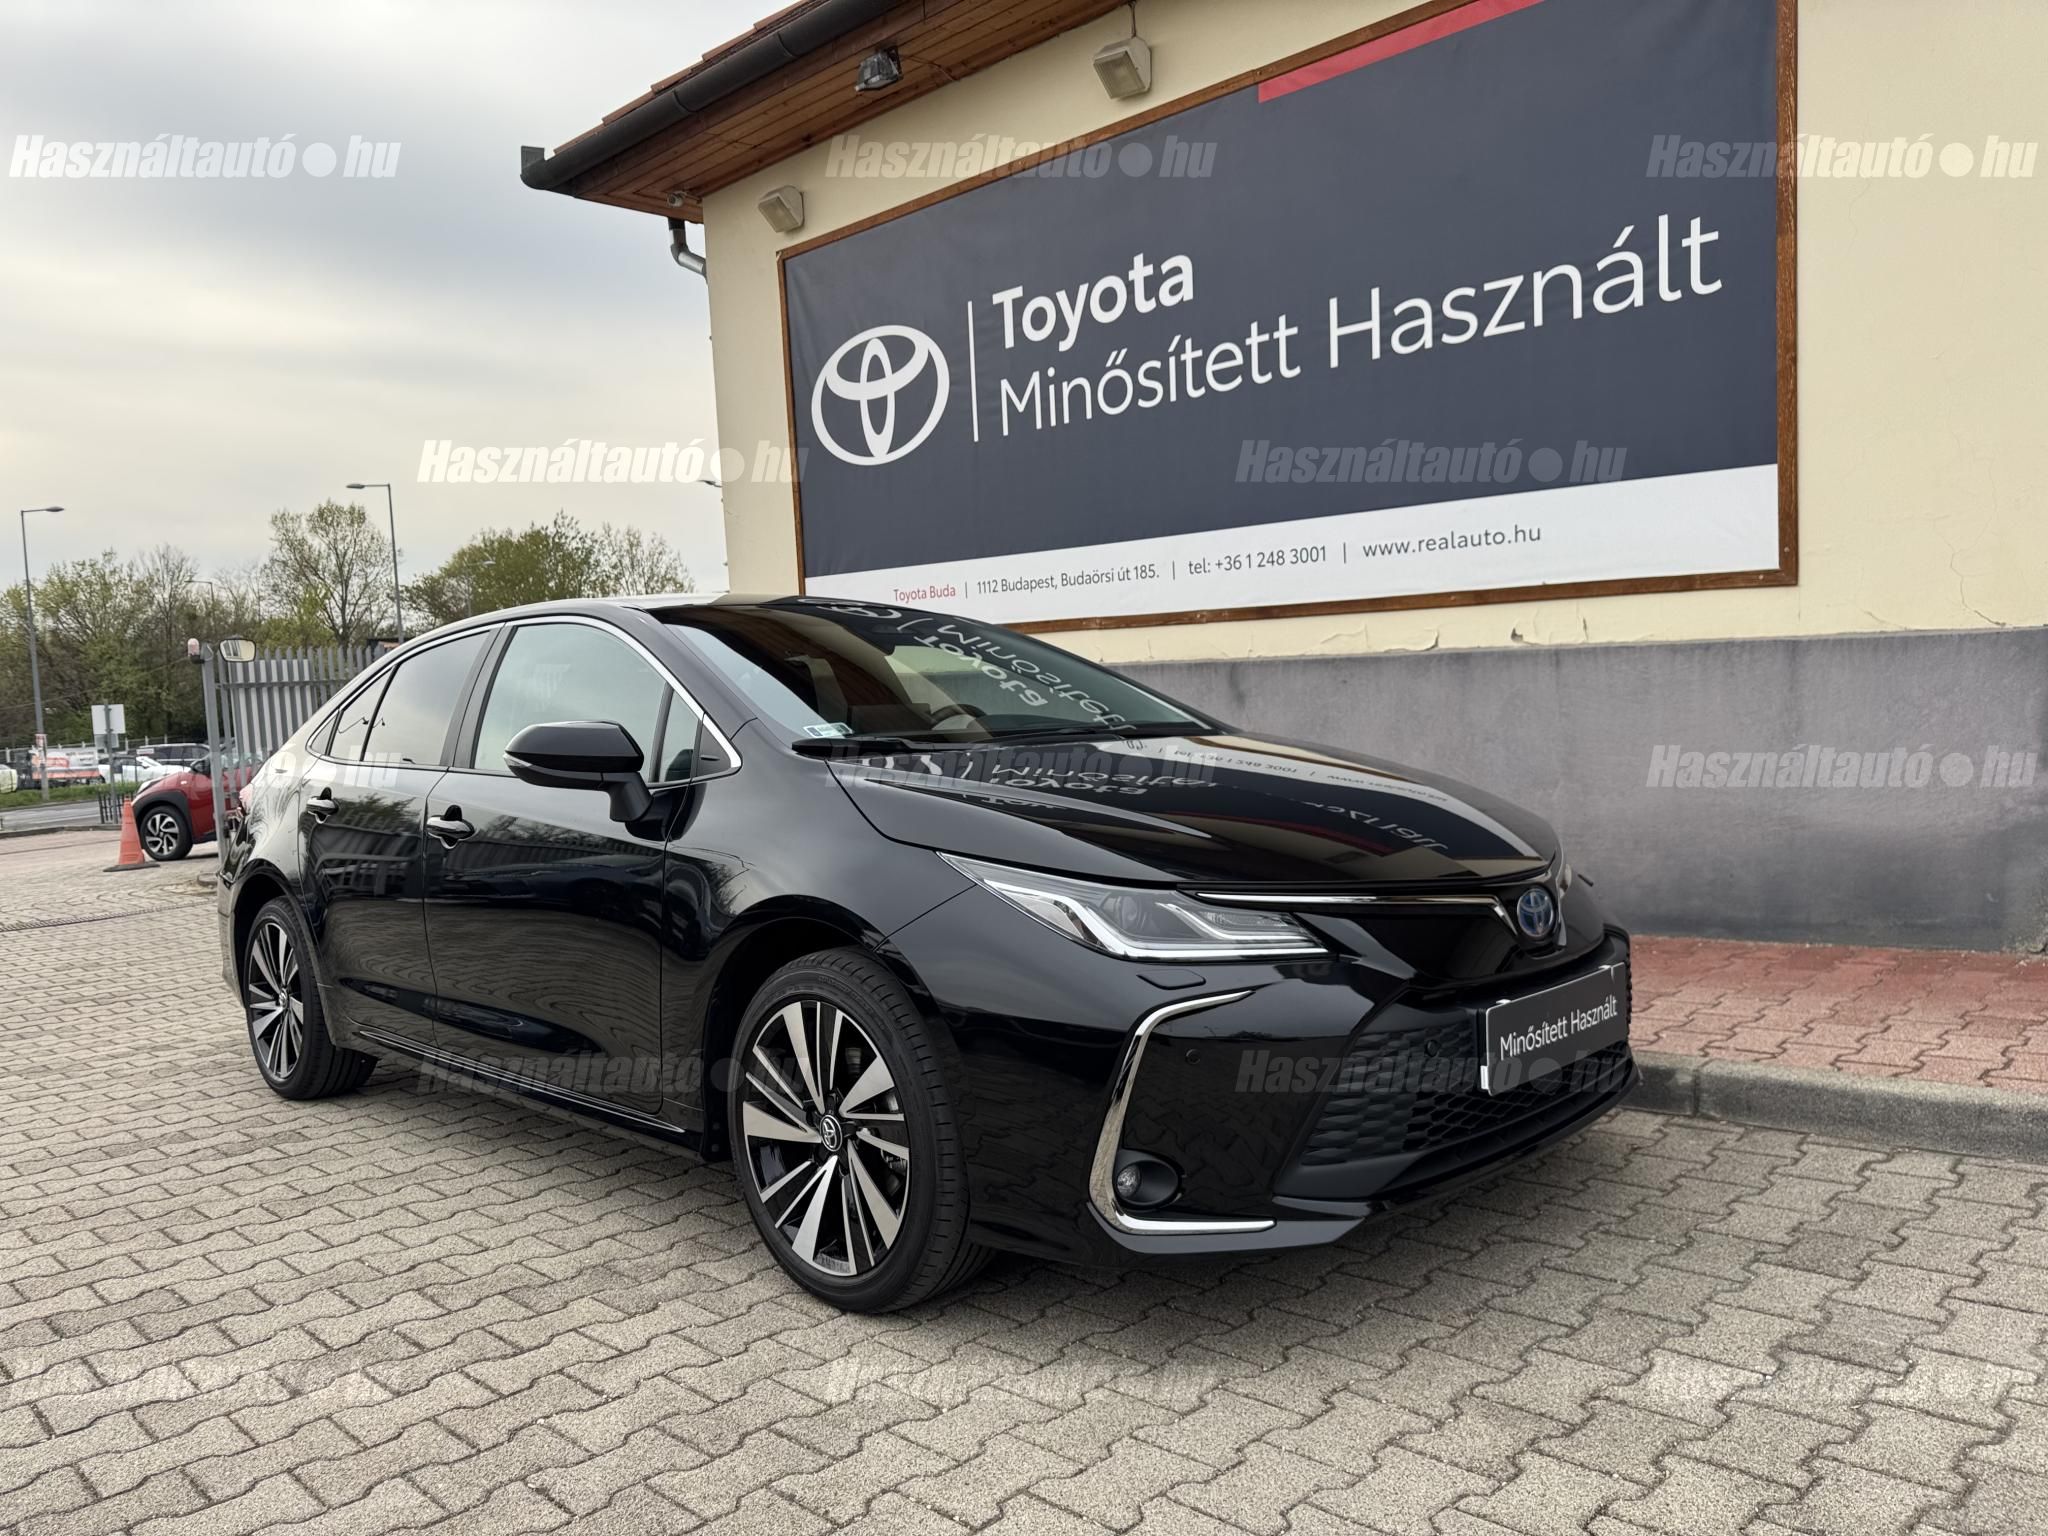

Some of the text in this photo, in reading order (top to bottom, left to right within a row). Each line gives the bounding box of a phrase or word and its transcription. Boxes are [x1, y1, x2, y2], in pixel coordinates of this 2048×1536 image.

[992, 252, 1194, 352] Toyota
[1000, 213, 1723, 437] Minősített Használt
[893, 587, 927, 604] Toyota
[929, 584, 956, 599] Buda
[977, 580, 999, 595] 1112
[1001, 574, 1058, 593] Budapest,
[1060, 567, 1114, 587] Budaörsi
[1117, 567, 1132, 581] út
[1133, 563, 1160, 580] 185.
[1188, 557, 1211, 576] tel:
[1290, 545, 1327, 565] 3001
[1362, 524, 1541, 558] www.realauto.hu
[1499, 994, 1618, 1061] Minősített Használt
